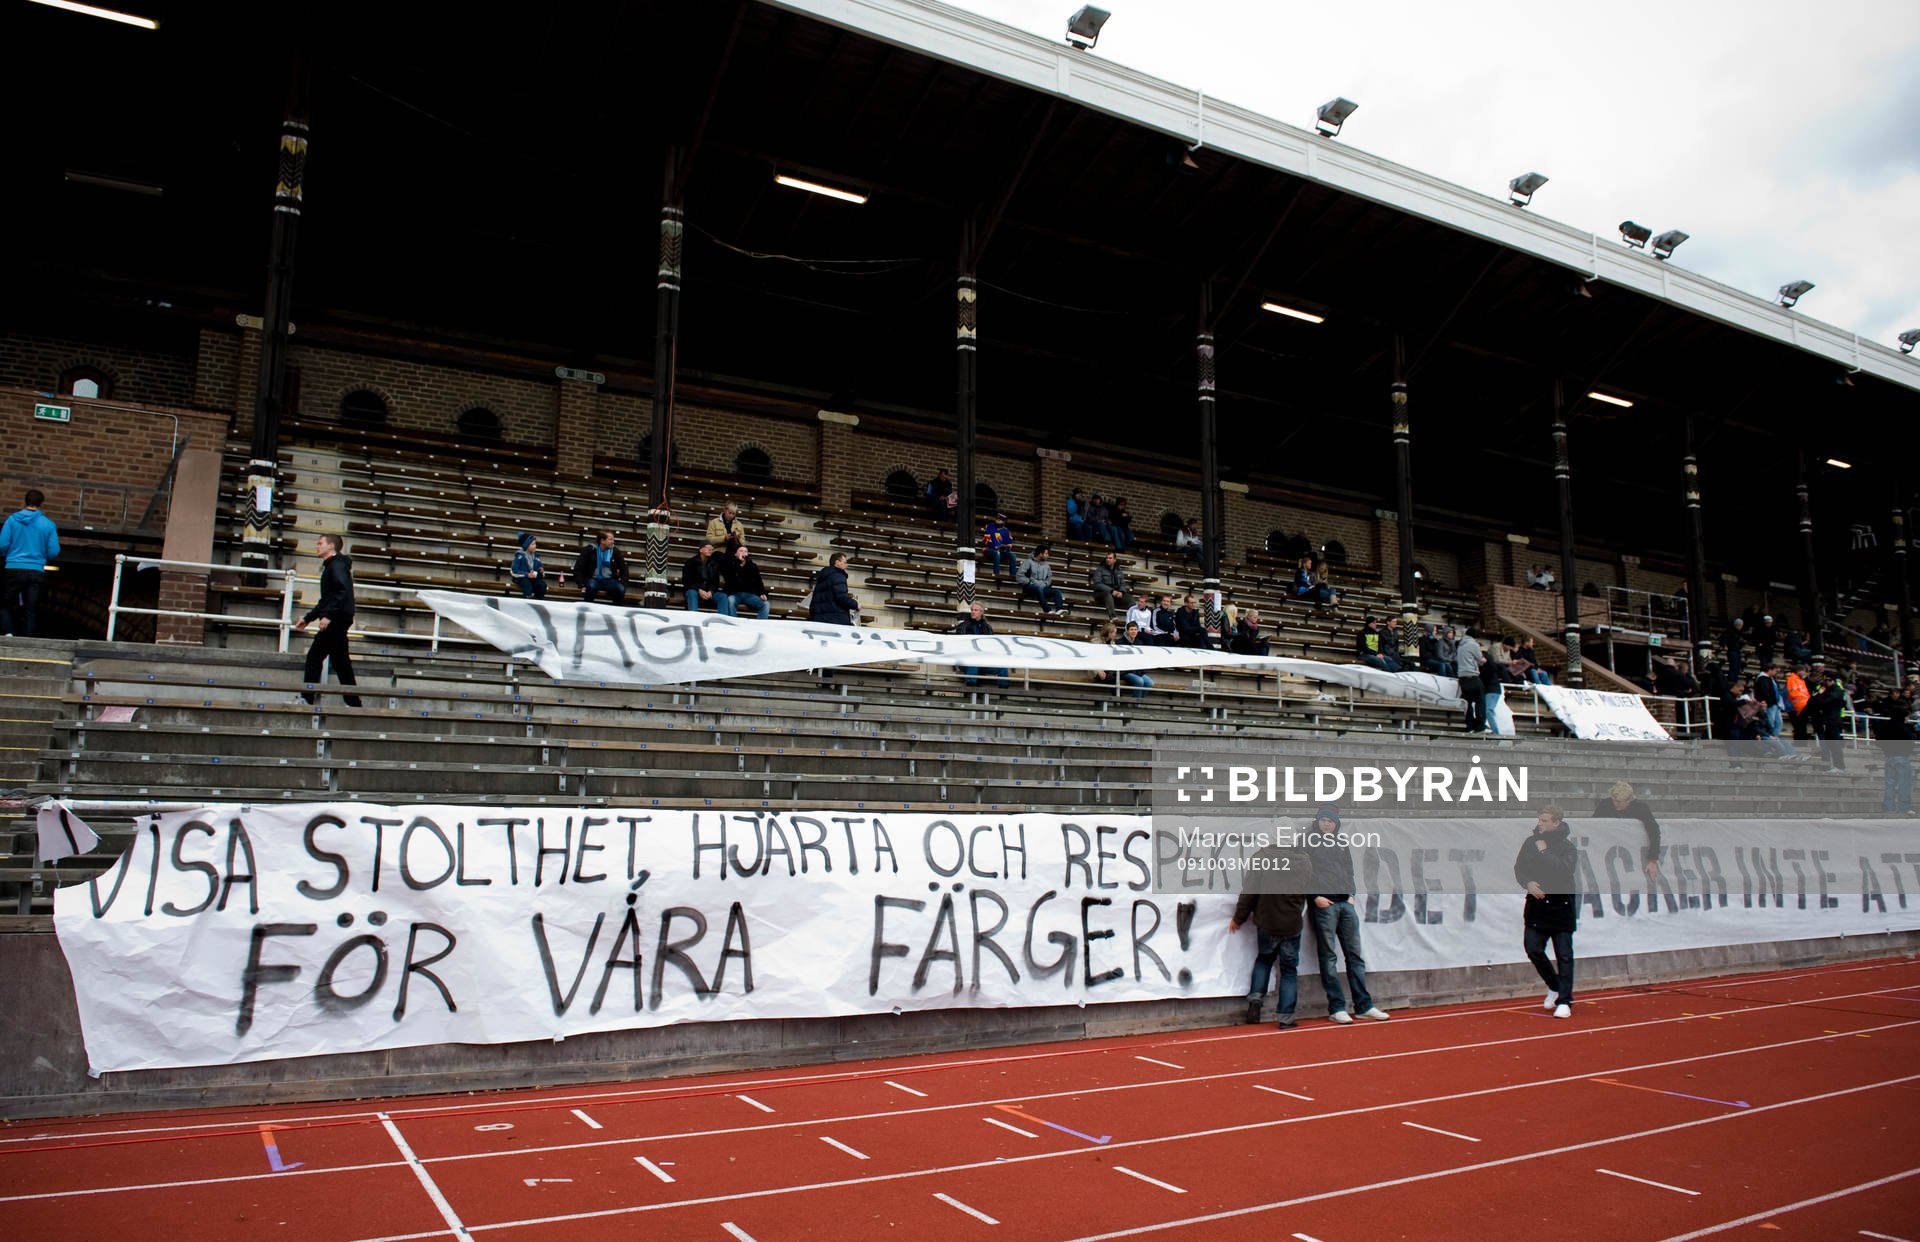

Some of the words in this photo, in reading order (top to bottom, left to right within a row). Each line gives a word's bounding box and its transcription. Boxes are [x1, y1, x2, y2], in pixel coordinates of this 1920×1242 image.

[60, 809, 259, 919] VISA
[296, 814, 653, 899] STOLTHET,
[692, 809, 899, 880] HJÄRTA
[924, 819, 1027, 881] OCH
[1363, 847, 1486, 925] DET
[1571, 836, 1728, 918] ÄCKER
[1735, 846, 1839, 910] INTE
[235, 911, 457, 1036] FÖR
[532, 892, 754, 1017] VÅRA
[869, 881, 1197, 998] FÄRGER!
